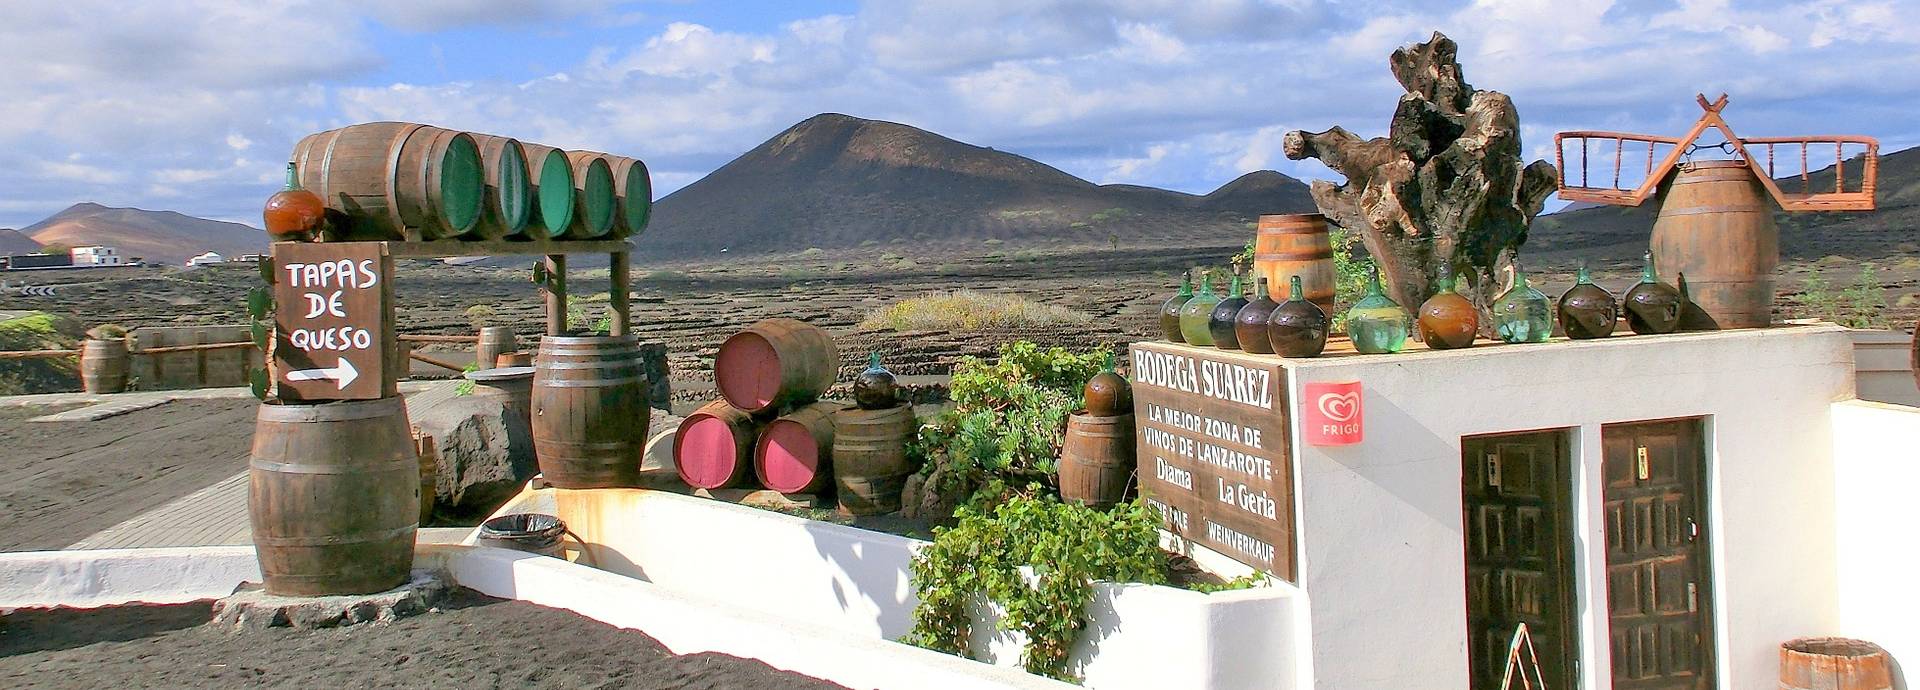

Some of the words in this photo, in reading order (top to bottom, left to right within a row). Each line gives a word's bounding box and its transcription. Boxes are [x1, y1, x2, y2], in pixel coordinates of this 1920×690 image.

[285, 259, 377, 288] TAPAS
[304, 290, 345, 319] DE
[290, 326, 371, 351] QUESO
[1135, 349, 1200, 394] BODEGA
[1201, 359, 1272, 409] SUAREZ
[1148, 404, 1163, 422] LA
[1165, 408, 1201, 431] MEJOR
[1205, 419, 1240, 442] ZONA
[1243, 427, 1262, 449] DE
[1323, 424, 1359, 435] FRIGO
[1143, 427, 1176, 452] VINOS
[1179, 437, 1194, 458] DE
[1197, 442, 1272, 481] LANZAROTE
[1156, 457, 1192, 490] Diama
[1219, 478, 1235, 505] La
[1238, 484, 1277, 520] Geria
[1207, 521, 1275, 564] WEINVERKAUF
